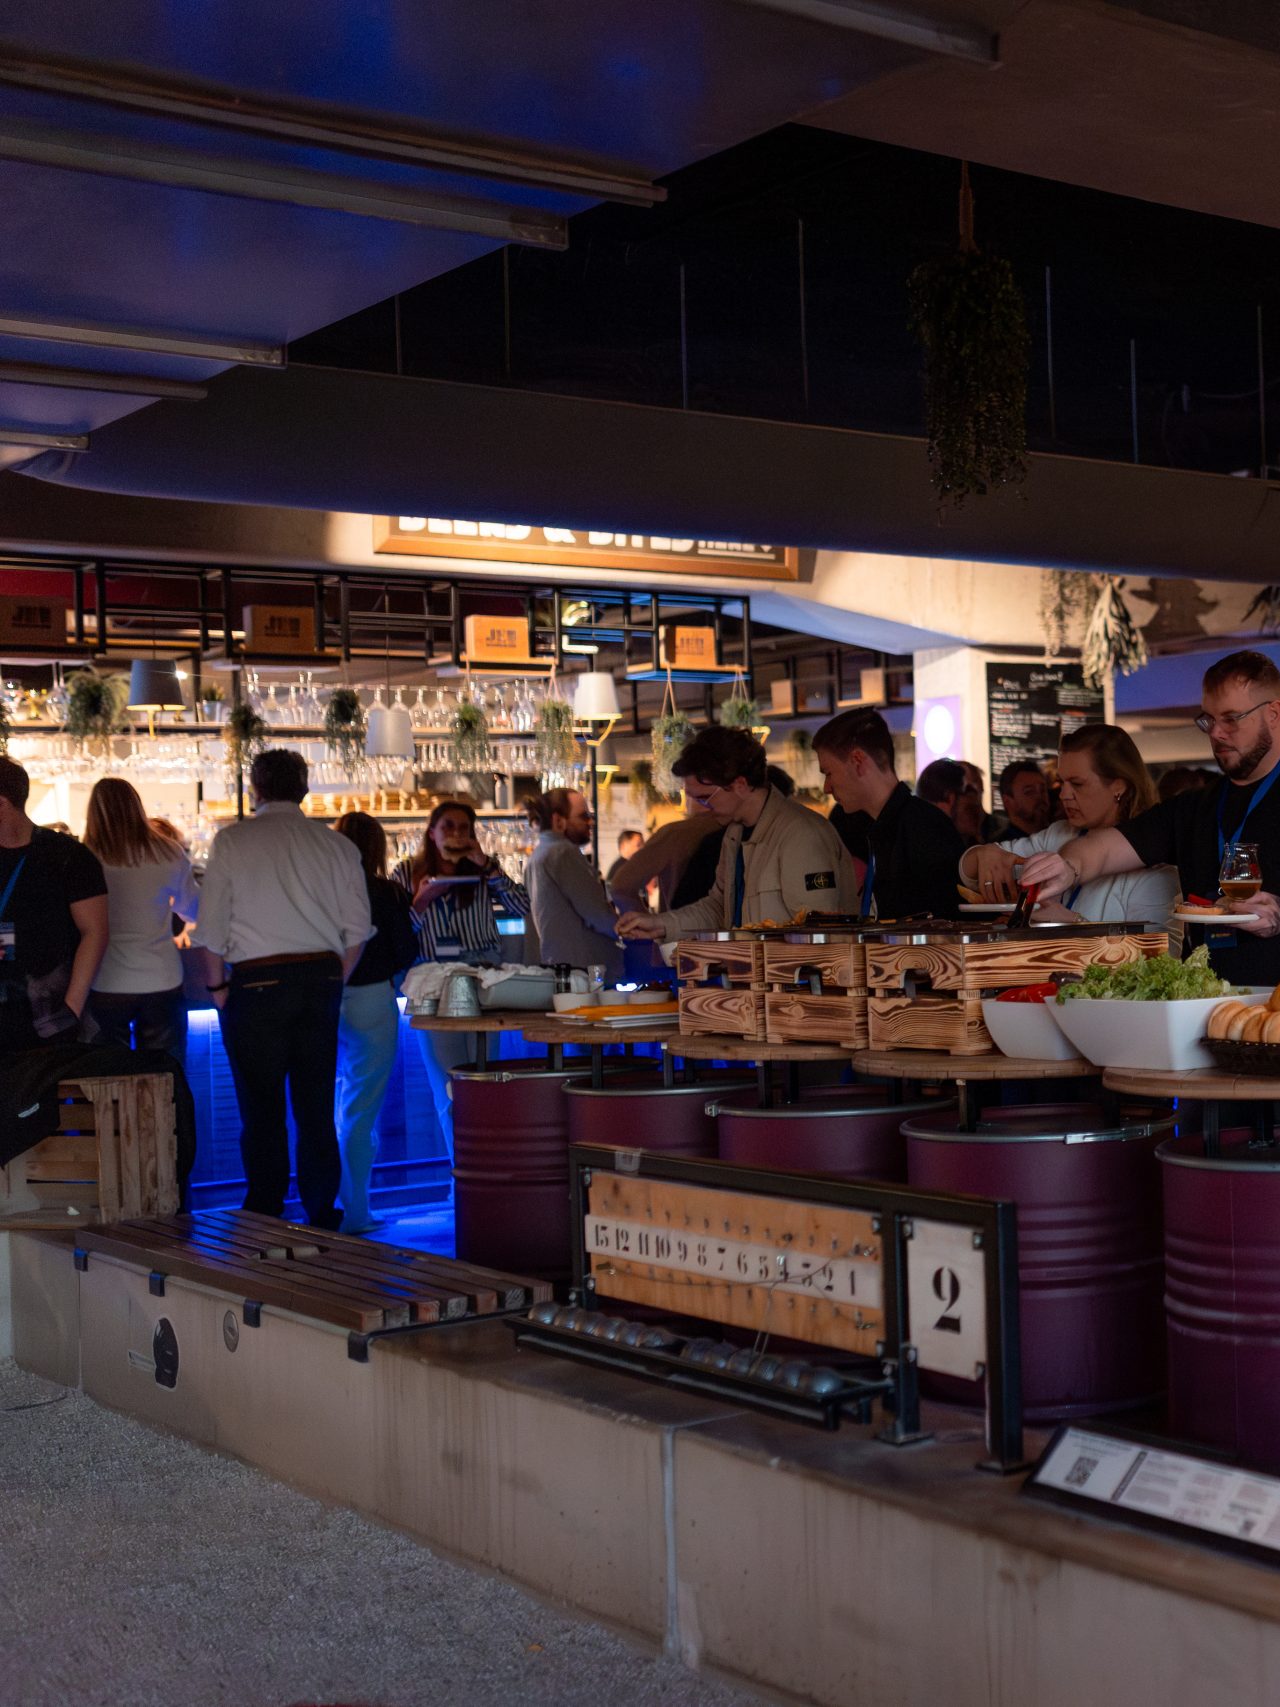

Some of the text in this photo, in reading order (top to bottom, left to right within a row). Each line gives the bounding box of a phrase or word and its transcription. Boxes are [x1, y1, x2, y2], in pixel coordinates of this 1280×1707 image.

[595, 1224, 856, 1296] 13 12 11 10 9 8 7 6 5 4 3 2 1
[932, 1266, 962, 1335] 2
